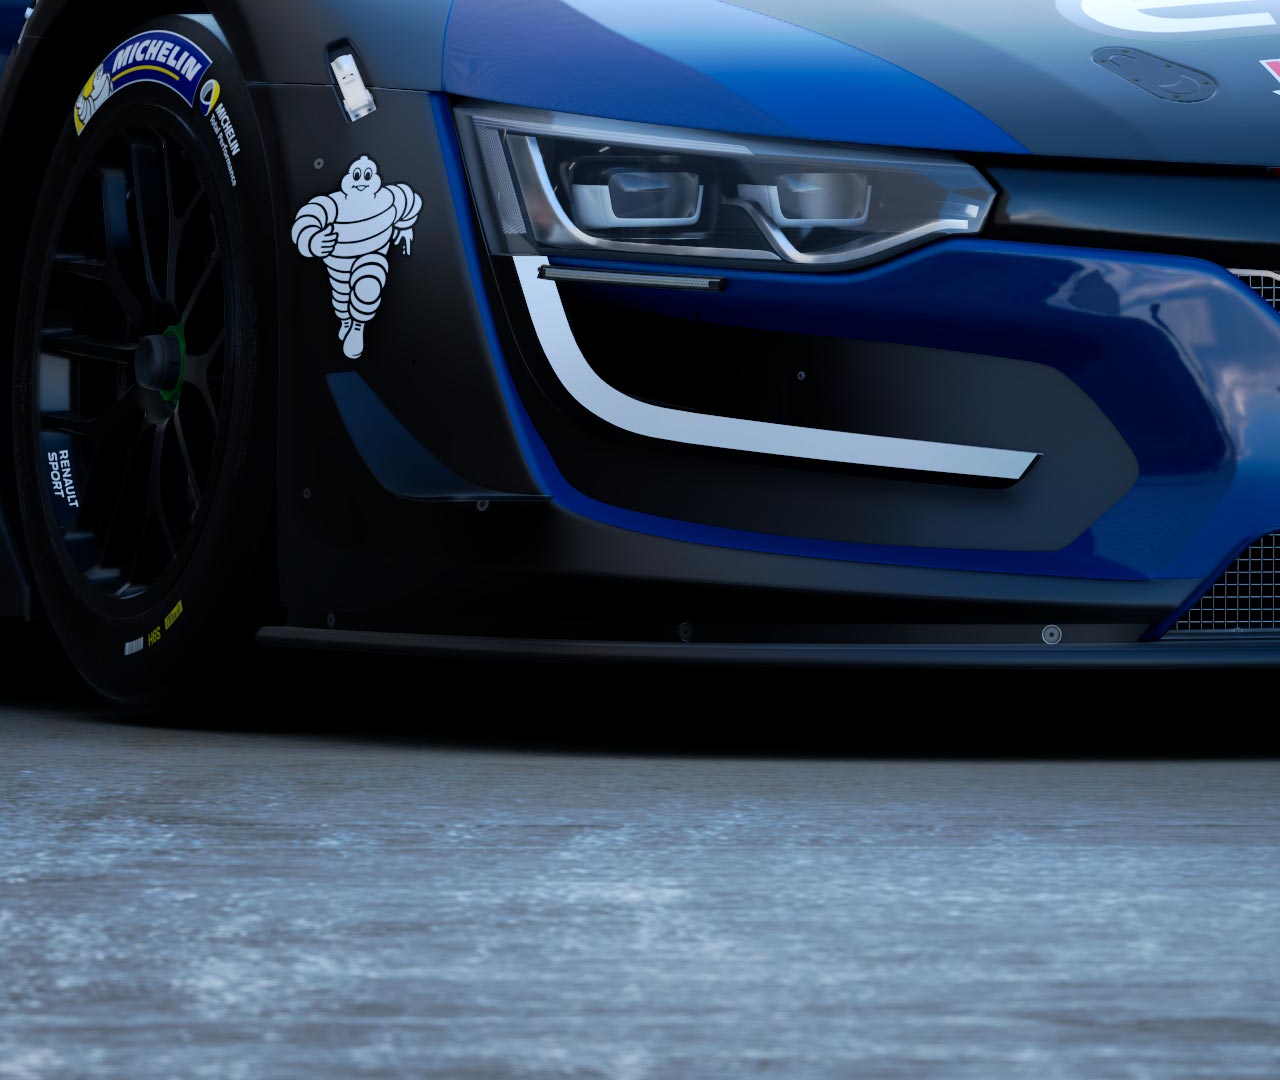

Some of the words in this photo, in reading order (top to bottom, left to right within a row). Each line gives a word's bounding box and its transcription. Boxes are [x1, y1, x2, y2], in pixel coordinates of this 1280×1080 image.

[111, 39, 202, 82] MICHELIN
[209, 113, 221, 136] Total
[217, 132, 237, 187] Performance
[215, 103, 240, 156] MICHELIN
[47, 451, 65, 498] SPORT
[58, 449, 80, 508] RENAULT
